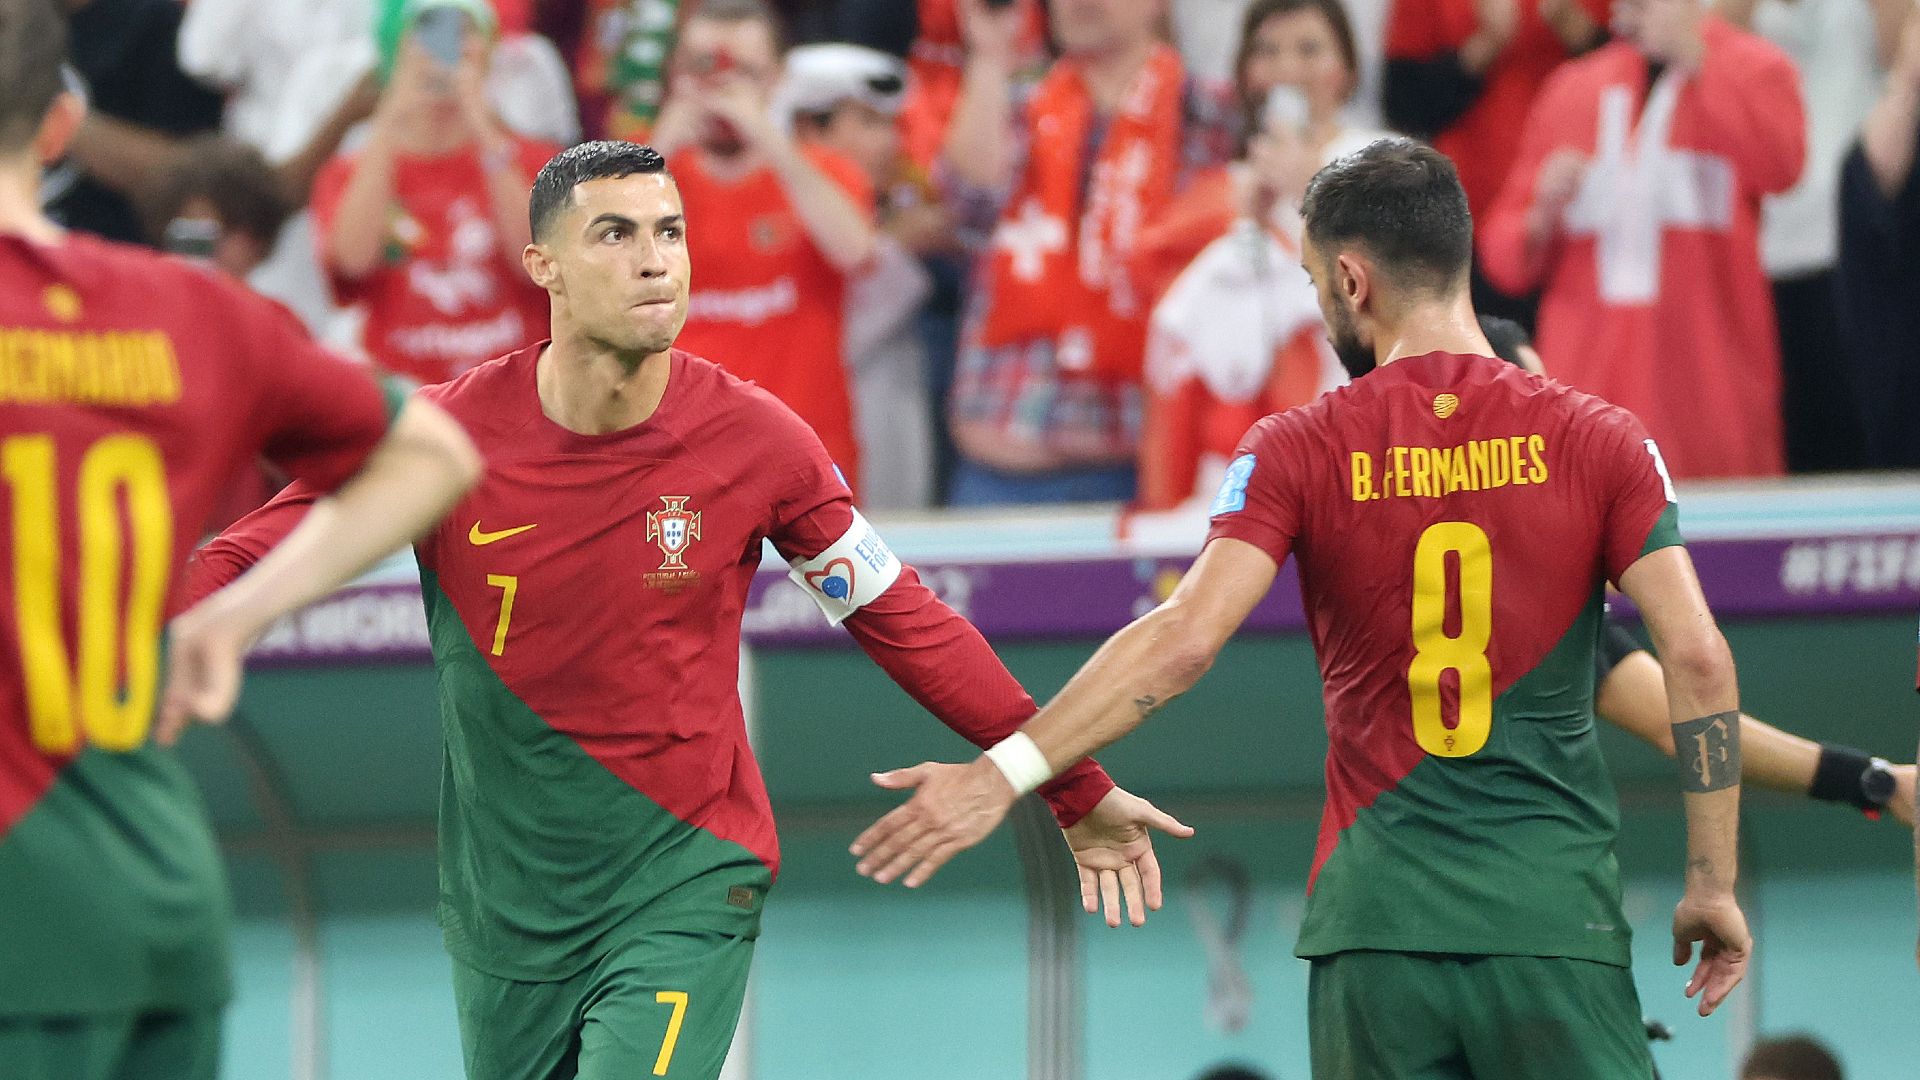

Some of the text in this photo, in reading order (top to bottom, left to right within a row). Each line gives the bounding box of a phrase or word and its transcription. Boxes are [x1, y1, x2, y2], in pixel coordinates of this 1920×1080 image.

[0, 433, 174, 752] 10
[486, 573, 518, 656] 7
[1408, 521, 1492, 758] 8
[653, 991, 689, 1076] 7
